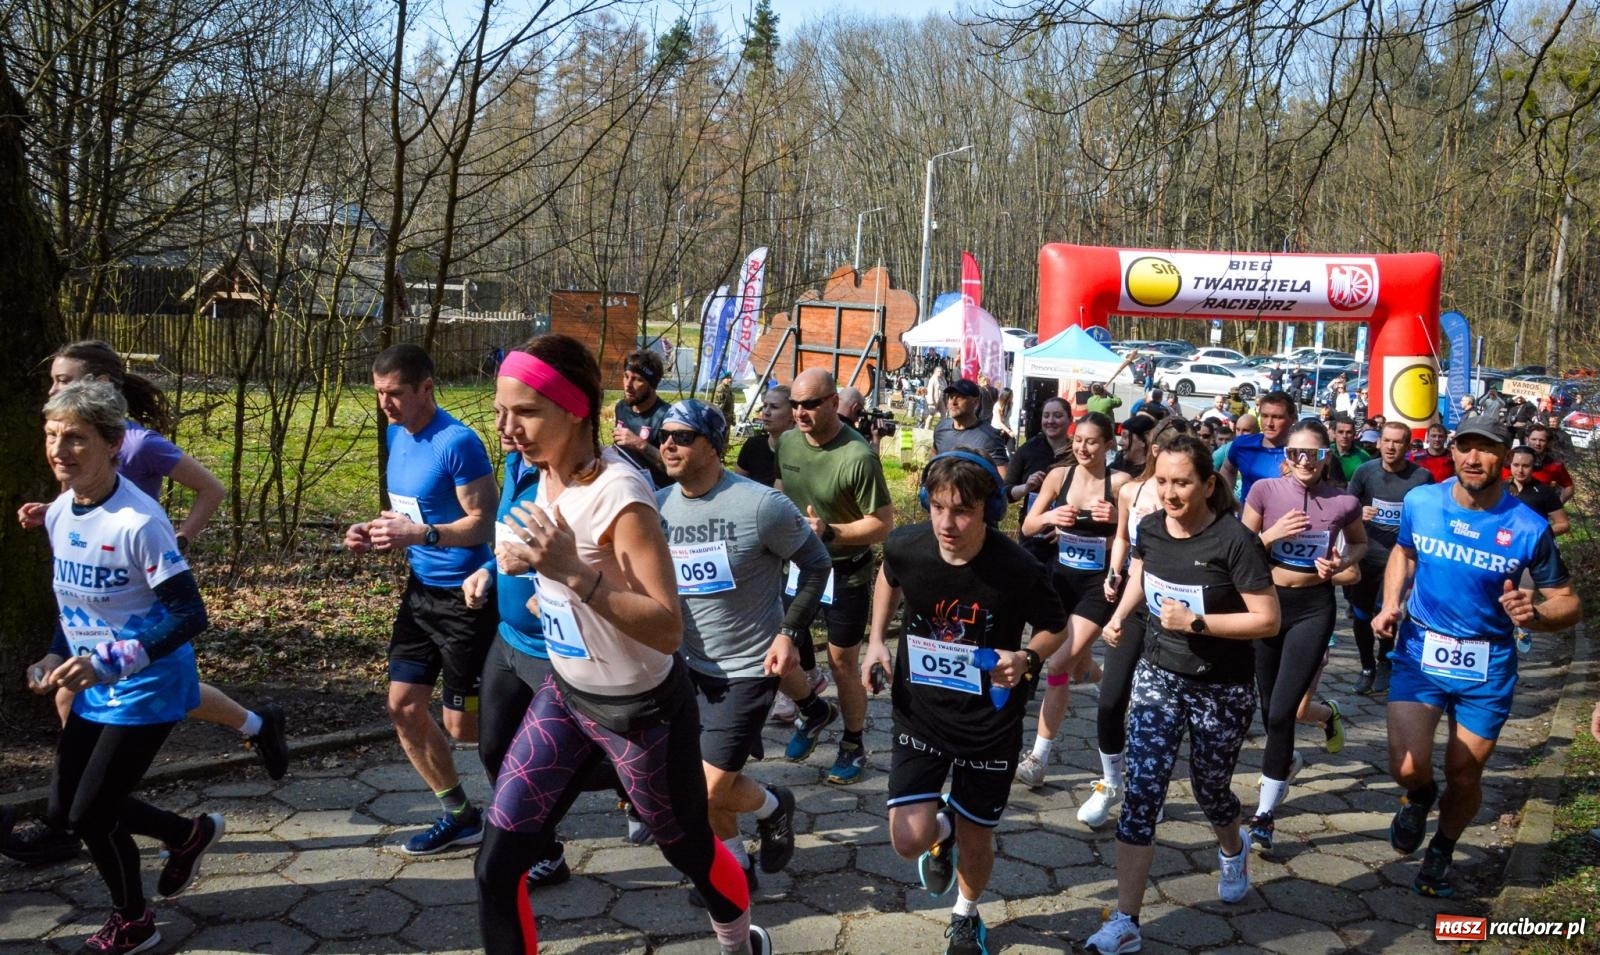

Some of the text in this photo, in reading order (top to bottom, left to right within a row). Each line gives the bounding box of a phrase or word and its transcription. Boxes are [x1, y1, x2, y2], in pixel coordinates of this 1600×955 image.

[1229, 259, 1272, 272] BIEG
[1192, 276, 1312, 293] TWARDZIELA
[1201, 295, 1298, 311] RACIBÓRZ
[1511, 381, 1540, 391] VAMOS
[1377, 508, 1401, 519] 009
[1066, 545, 1096, 561] 075
[1281, 541, 1318, 558] 027
[1411, 532, 1521, 574] RUNNERS
[54, 556, 130, 589] NNERS
[681, 560, 718, 581] 069
[542, 611, 565, 640] 71
[921, 654, 967, 678] 052
[1434, 647, 1476, 668] 036
